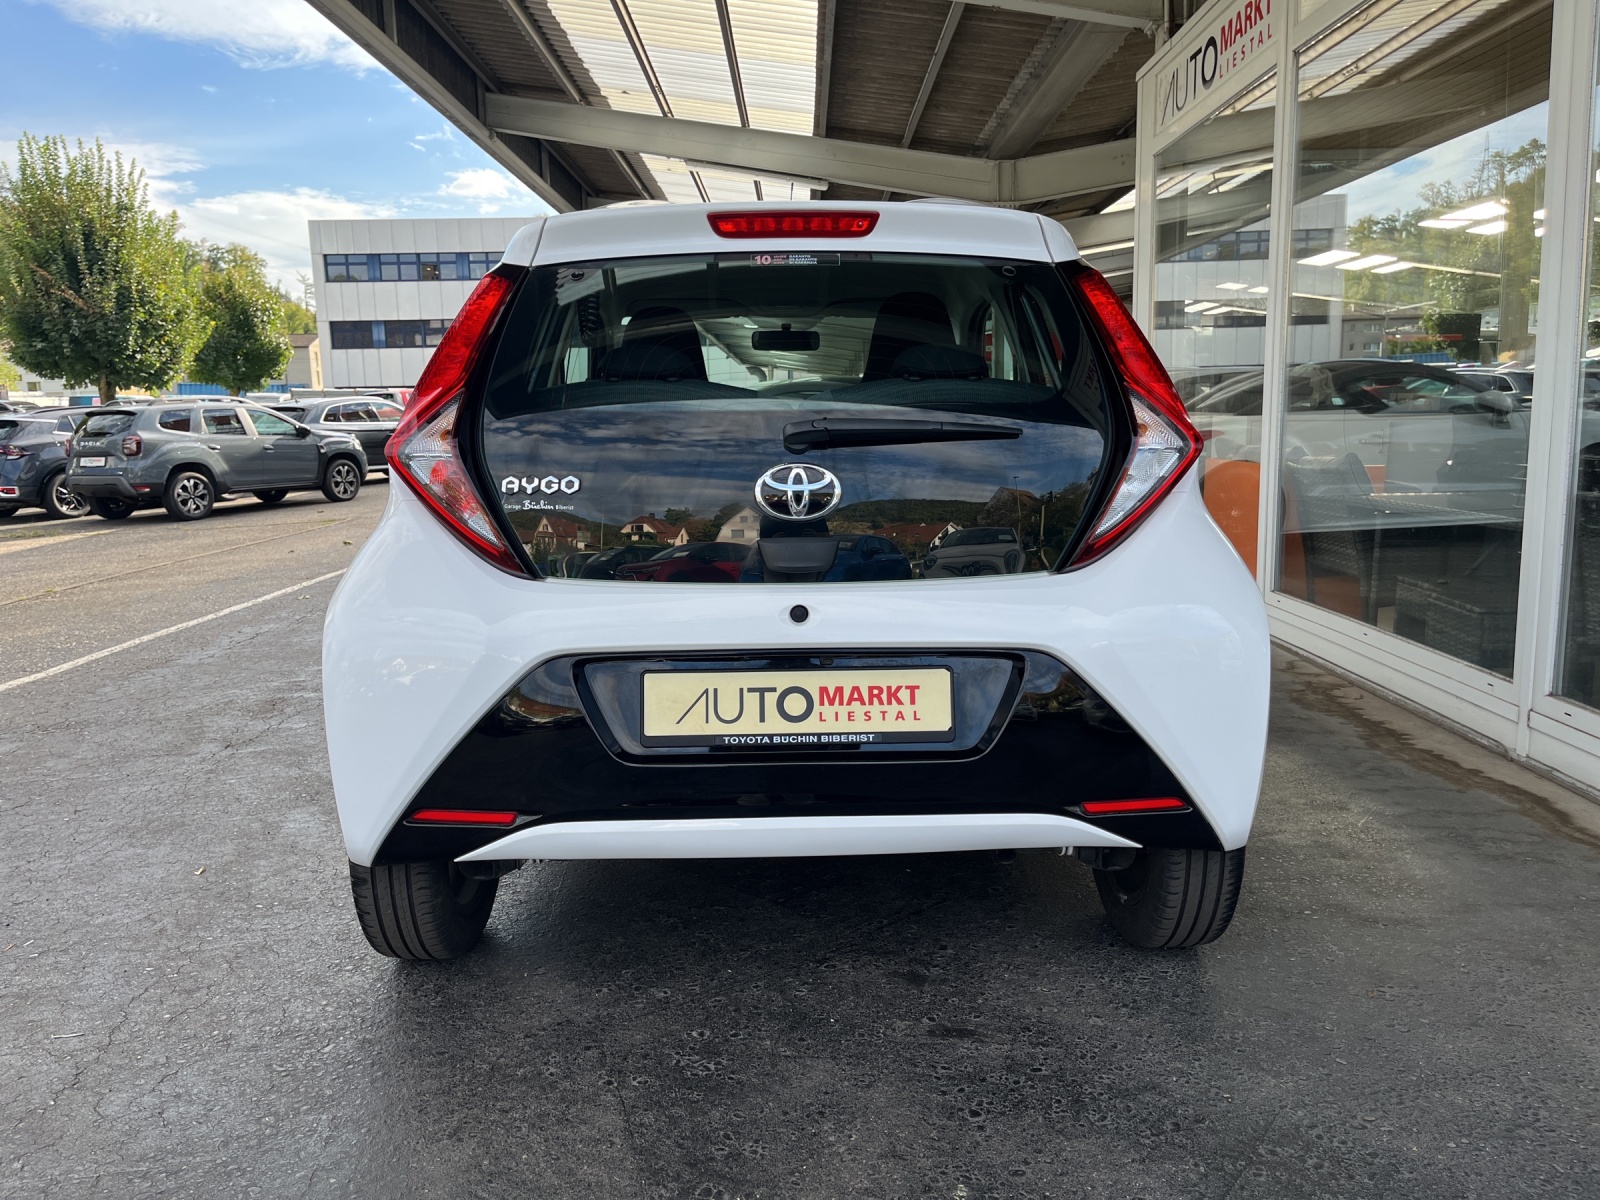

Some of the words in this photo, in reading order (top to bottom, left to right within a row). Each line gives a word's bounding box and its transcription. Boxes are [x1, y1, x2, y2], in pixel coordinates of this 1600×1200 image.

[1219, 23, 1273, 79] LIESTAL
[1161, 36, 1218, 126] AUTO
[754, 255, 771, 265] 10
[501, 475, 582, 495] AYGO
[522, 500, 554, 510] Büchin
[675, 685, 815, 725] AUTO
[818, 685, 921, 707] MARKT
[818, 710, 921, 723] LIESTAL
[723, 736, 771, 744] TOYOTA
[820, 734, 875, 742] BIBERIST
